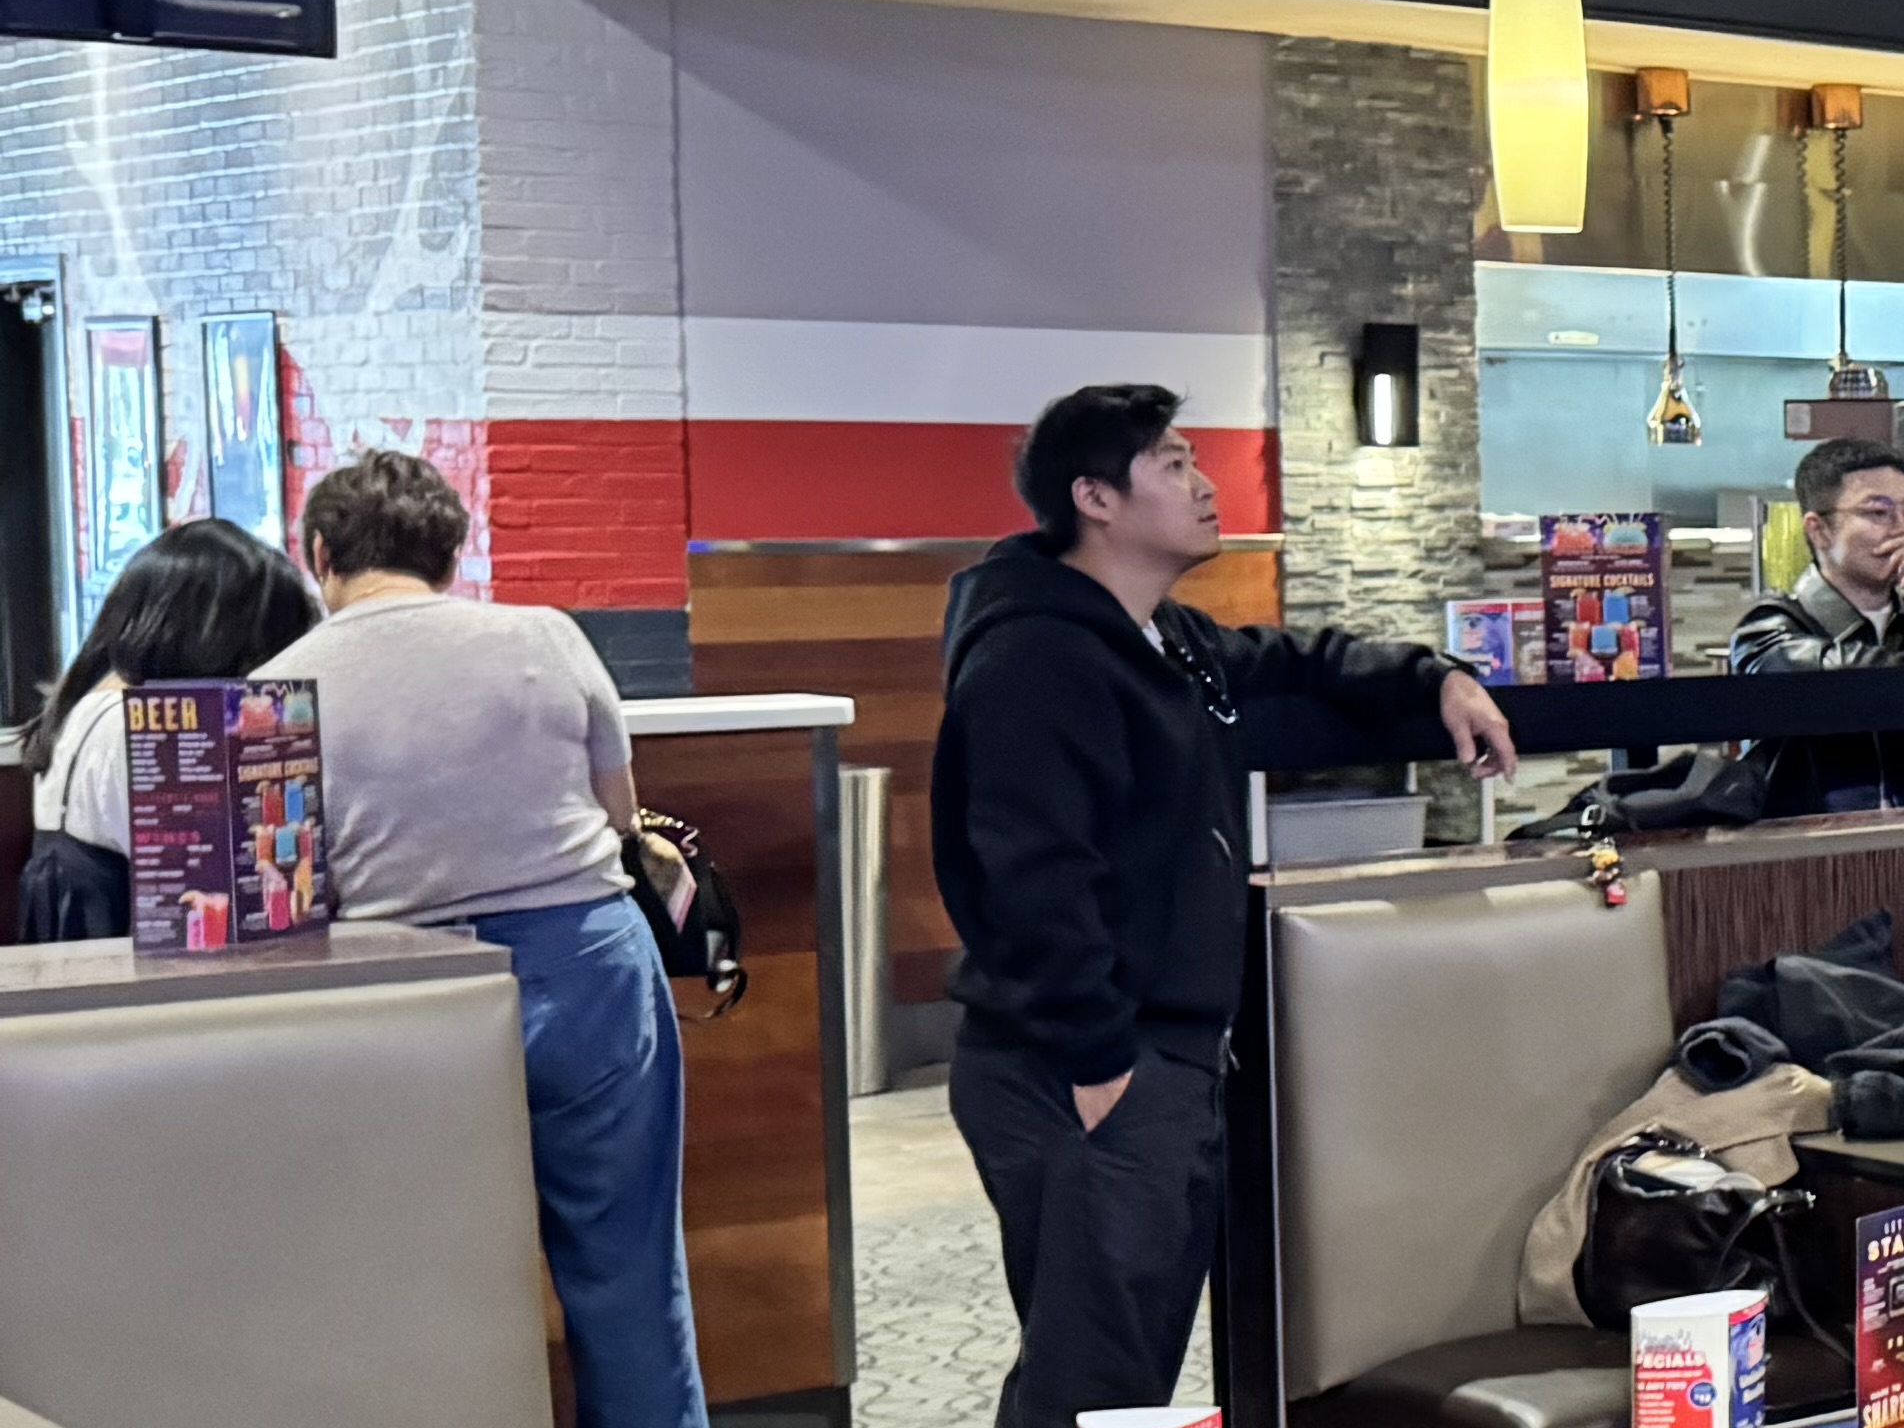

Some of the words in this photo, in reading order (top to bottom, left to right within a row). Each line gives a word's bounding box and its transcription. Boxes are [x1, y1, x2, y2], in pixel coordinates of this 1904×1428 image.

[1550, 573, 1601, 589] SIGNATURE
[1603, 572, 1655, 588] COCKTAILS
[127, 696, 198, 732] BEER
